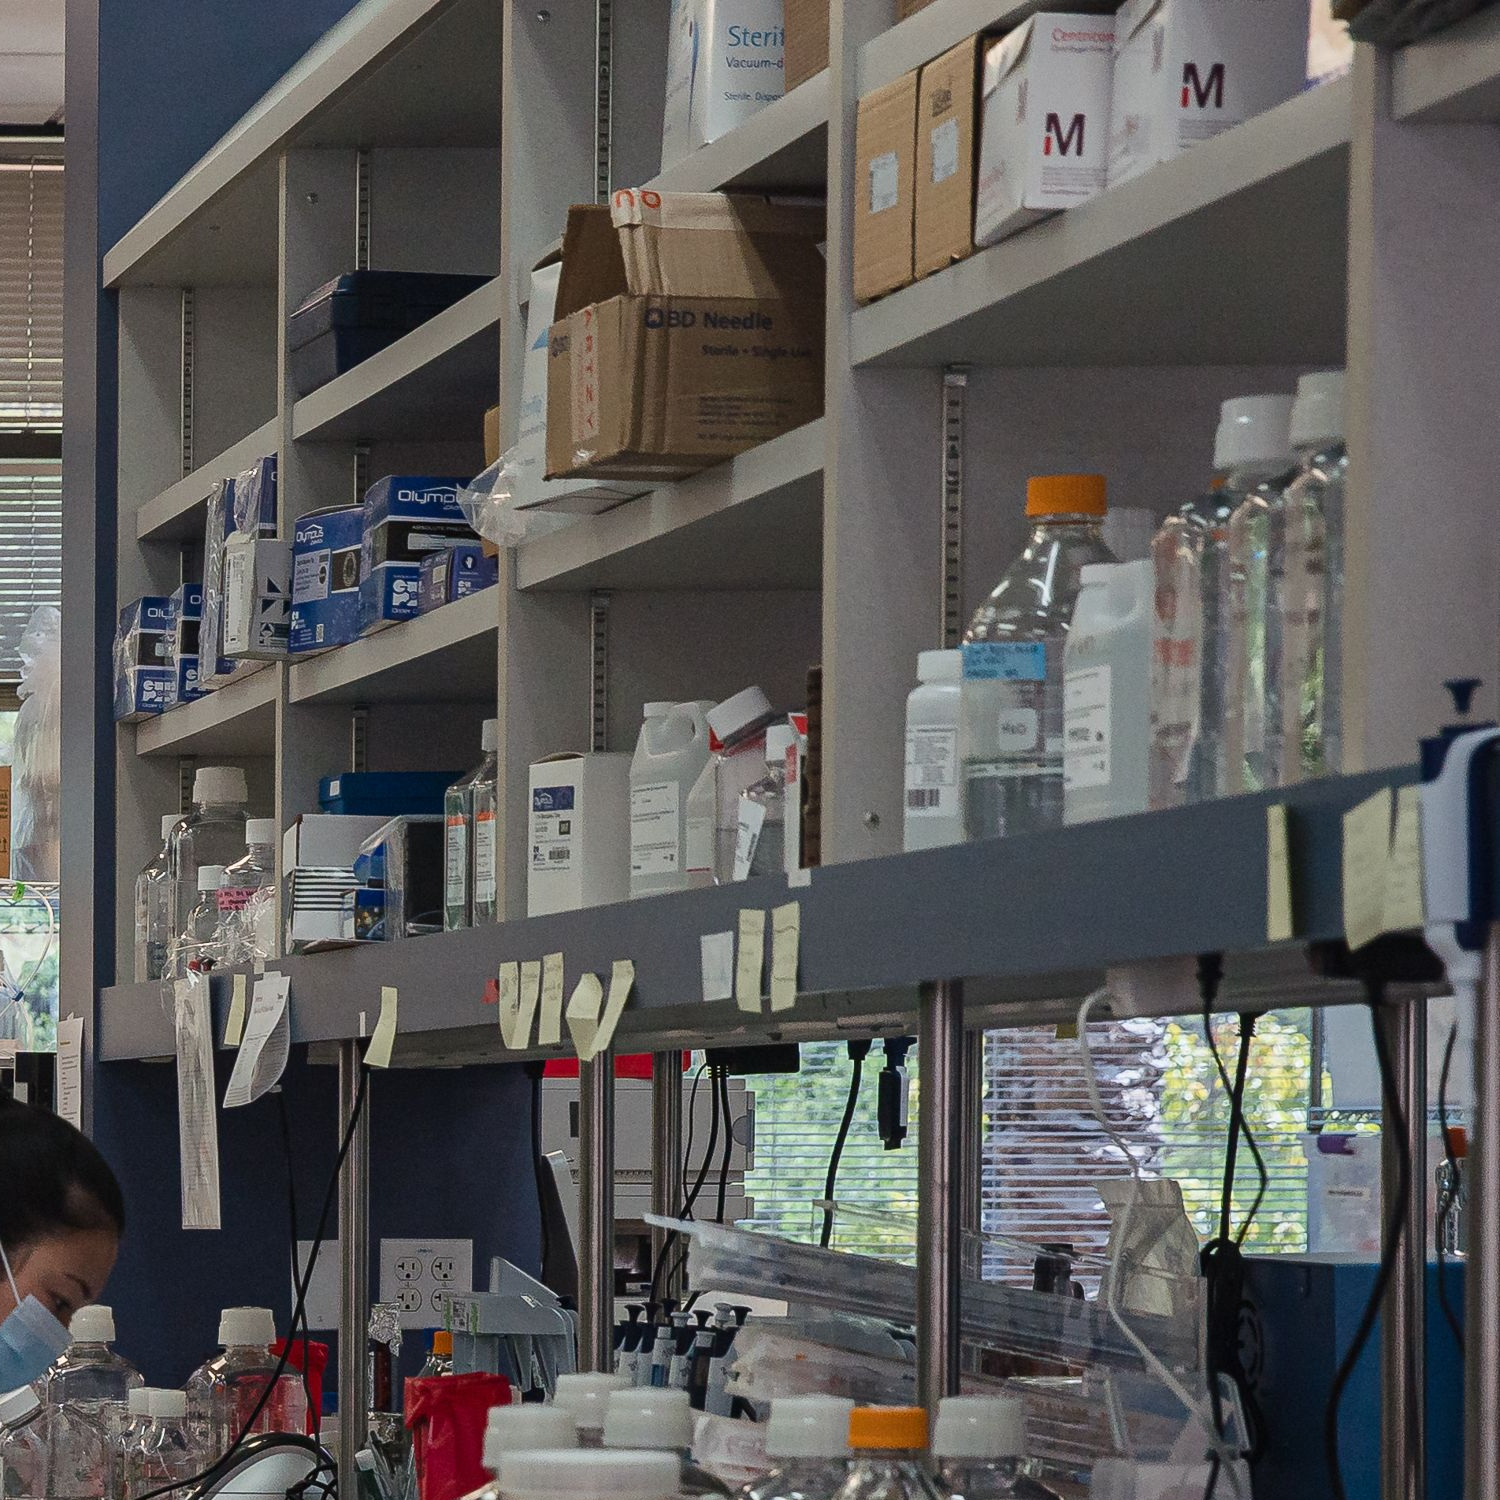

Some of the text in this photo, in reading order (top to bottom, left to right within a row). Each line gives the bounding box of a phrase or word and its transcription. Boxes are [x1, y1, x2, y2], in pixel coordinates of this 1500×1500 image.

[667, 310, 773, 331] BD Needle
[397, 489, 459, 505] Olymp
